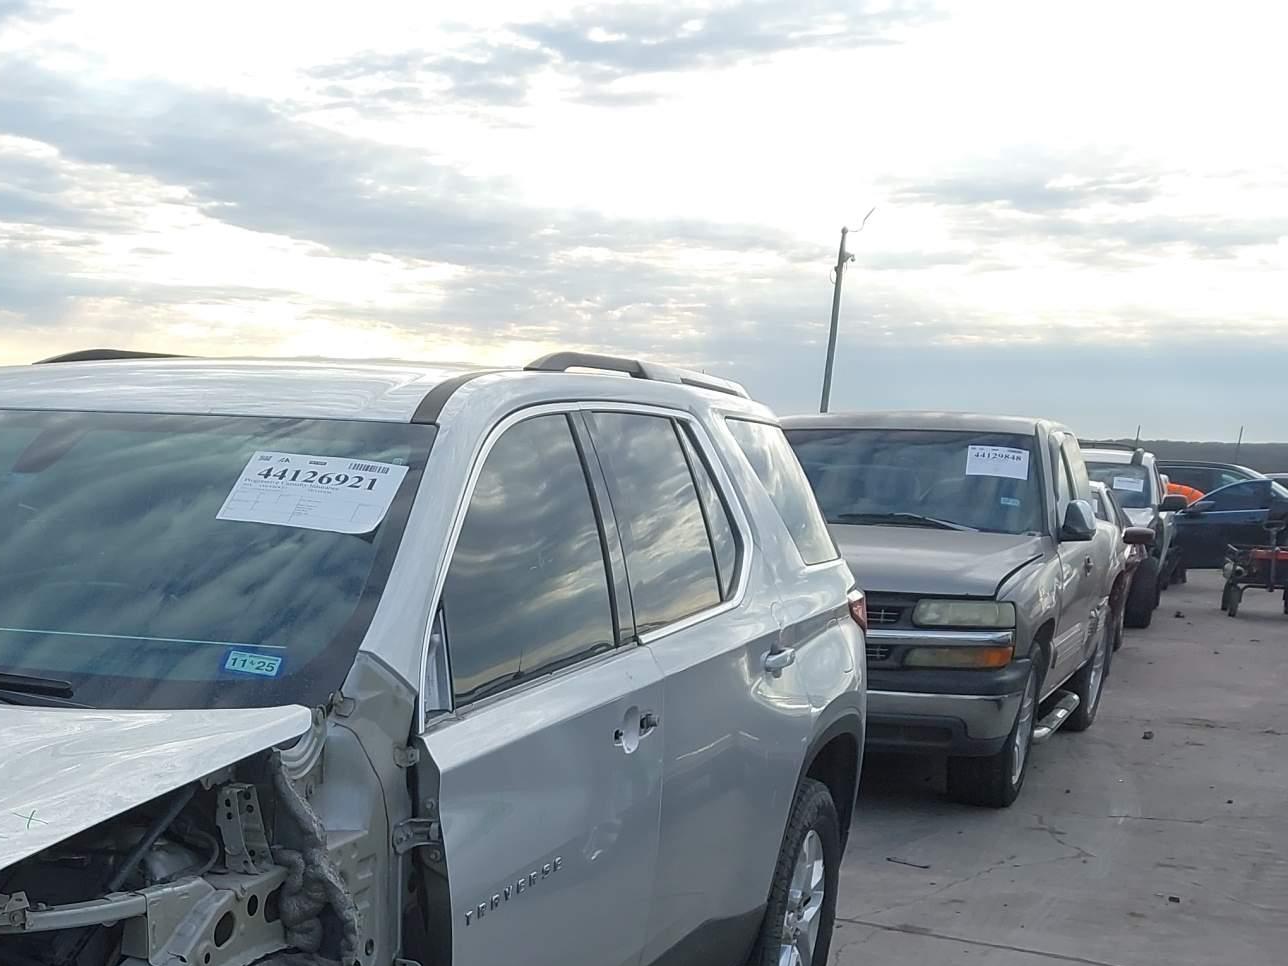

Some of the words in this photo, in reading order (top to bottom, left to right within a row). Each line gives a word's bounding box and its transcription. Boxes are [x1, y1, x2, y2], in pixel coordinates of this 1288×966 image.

[257, 466, 377, 491] 44126921
[255, 660, 277, 673] 25
[465, 856, 562, 926] TRAVERSE
